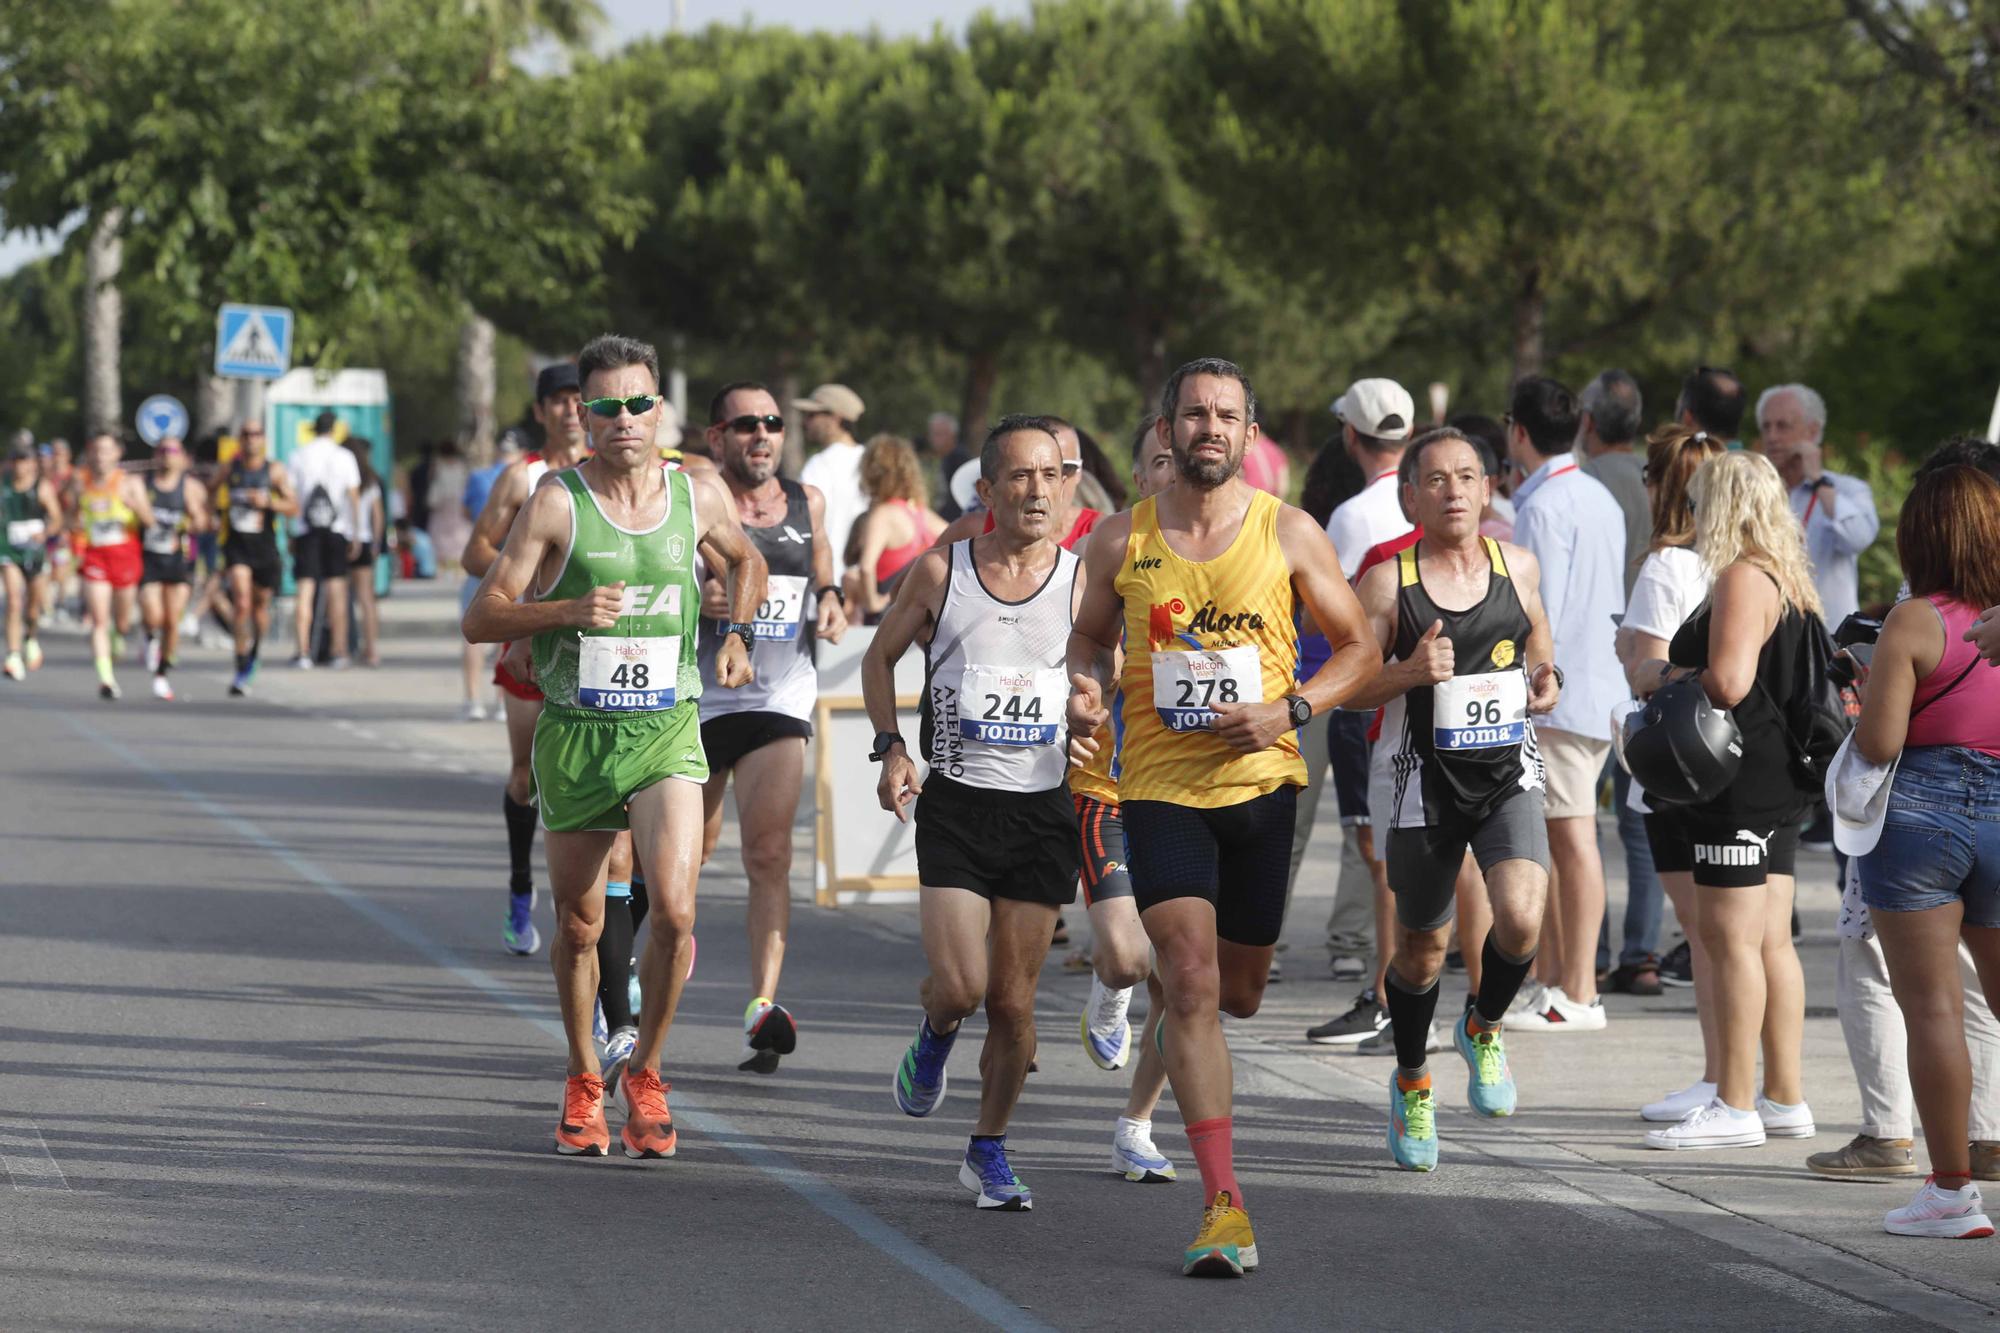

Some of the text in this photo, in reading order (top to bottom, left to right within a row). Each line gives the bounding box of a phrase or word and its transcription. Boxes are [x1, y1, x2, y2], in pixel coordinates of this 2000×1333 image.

[619, 584, 682, 616] EA
[756, 599, 785, 620] 02
[1187, 600, 1264, 634] Álora
[610, 663, 649, 689] 48
[1175, 678, 1239, 708] 278
[983, 693, 1043, 723] 244
[1172, 712, 1221, 729] Jom
[1466, 699, 1501, 726] 96
[1694, 843, 1760, 866] PUMA
